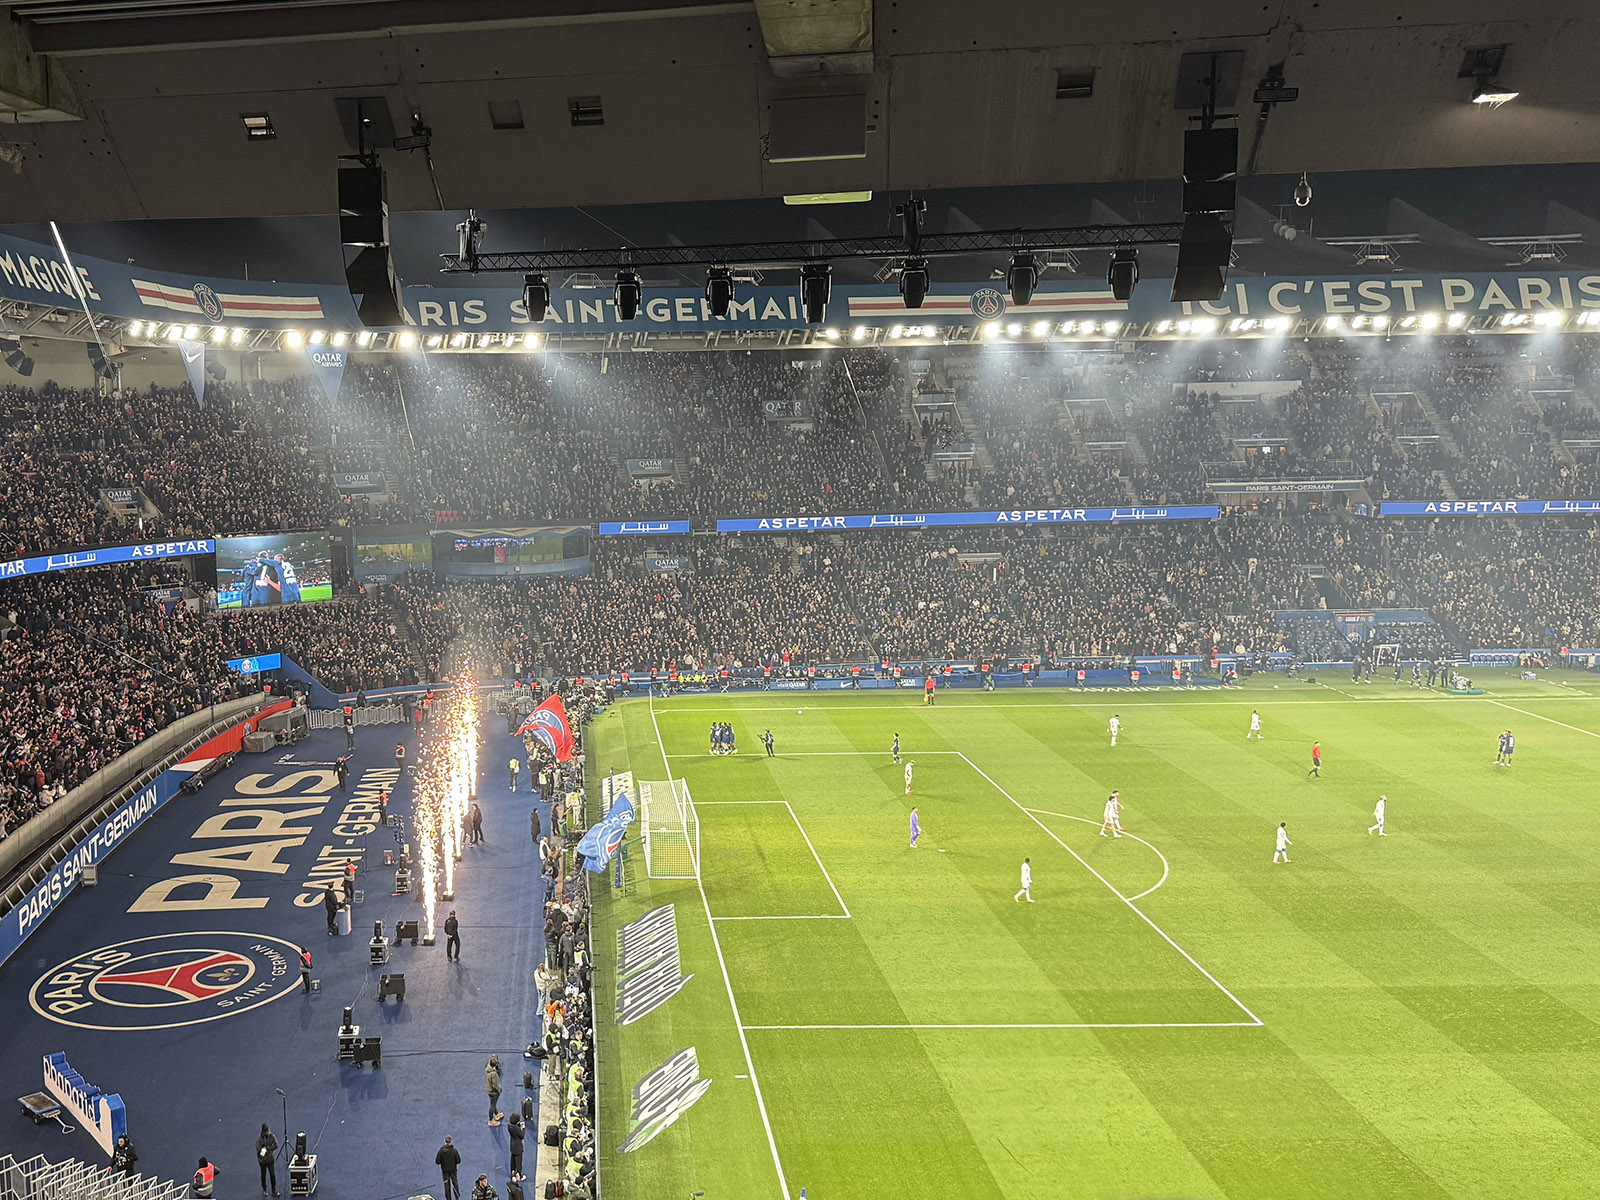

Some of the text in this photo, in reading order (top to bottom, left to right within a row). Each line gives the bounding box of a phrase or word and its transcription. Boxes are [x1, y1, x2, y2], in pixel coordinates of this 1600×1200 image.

[1268, 280, 1424, 315] C'EST
[1441, 275, 1600, 311] PARIS
[313, 353, 342, 363] QATAR
[765, 402, 801, 413] QATR
[639, 460, 662, 468] QATAR
[345, 474, 370, 482] QATAR
[1271, 484, 1334, 492] SAINT-GERMAIN
[107, 490, 132, 499] QATAR
[1424, 501, 1518, 513] ASPETAR
[996, 509, 1087, 522] ASPETAR
[757, 516, 847, 529] ASPETAR
[132, 540, 209, 557] ASPETAR
[655, 559, 679, 567] QATAR
[126, 769, 340, 913] PARIS
[18, 785, 157, 936] PARIS SAINT-GERMAIN
[44, 949, 132, 1015] PARIS
